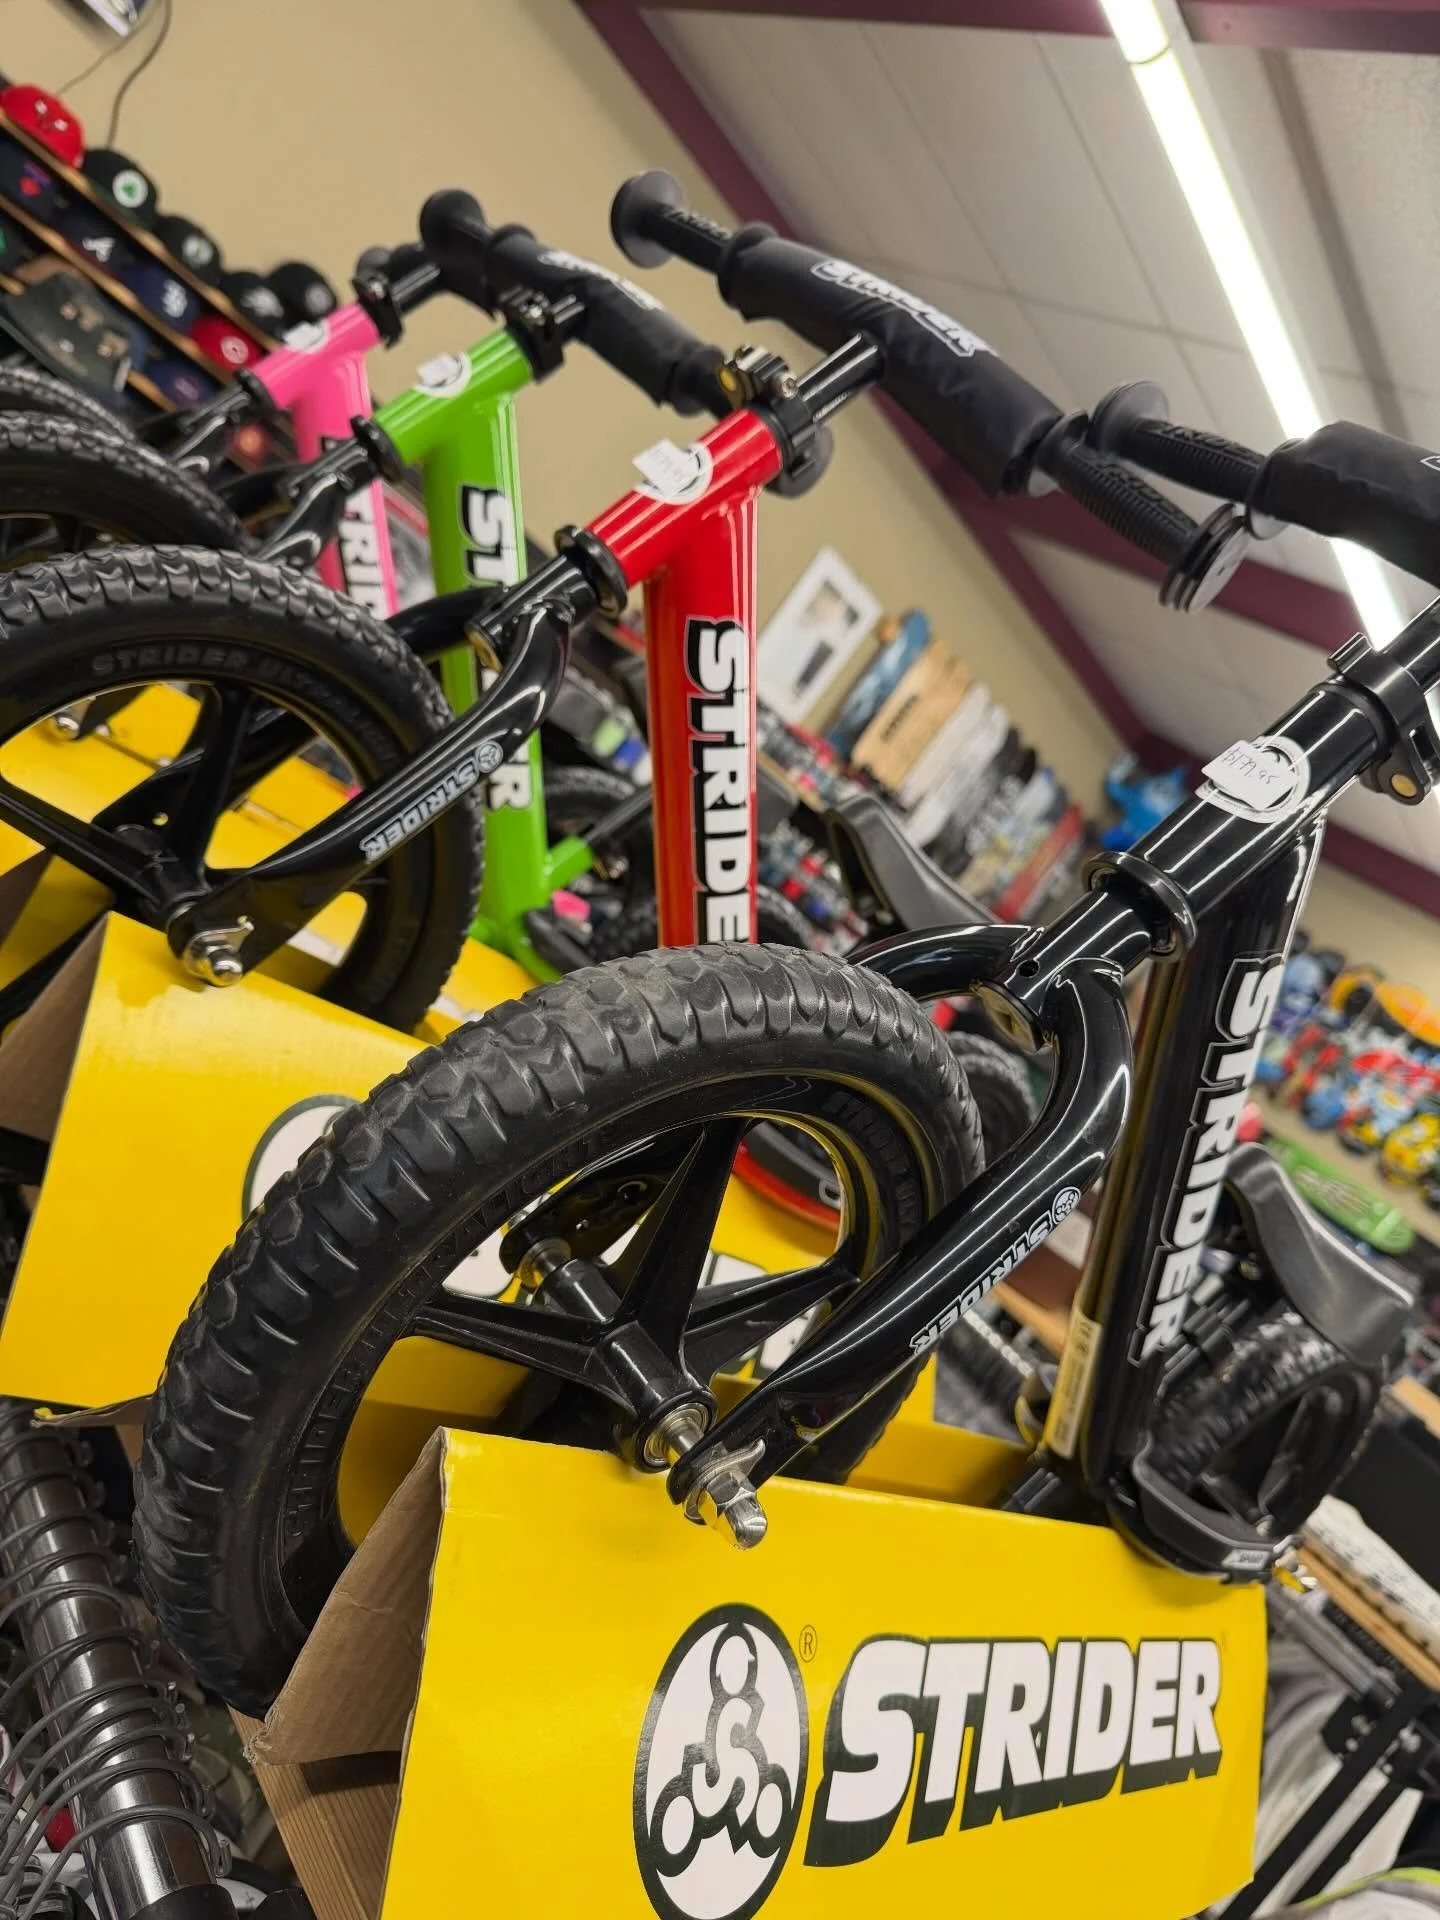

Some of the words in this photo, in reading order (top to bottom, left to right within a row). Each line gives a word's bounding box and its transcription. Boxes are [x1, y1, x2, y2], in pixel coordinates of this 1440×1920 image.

[91, 643, 248, 676] STRIDER
[359, 757, 481, 862] STRIDER
[684, 616, 750, 946] STRIDE
[1127, 955, 1285, 1368] STRIDER
[909, 1210, 1054, 1356] STRIDER
[804, 1633, 1222, 1867] STRIDER
